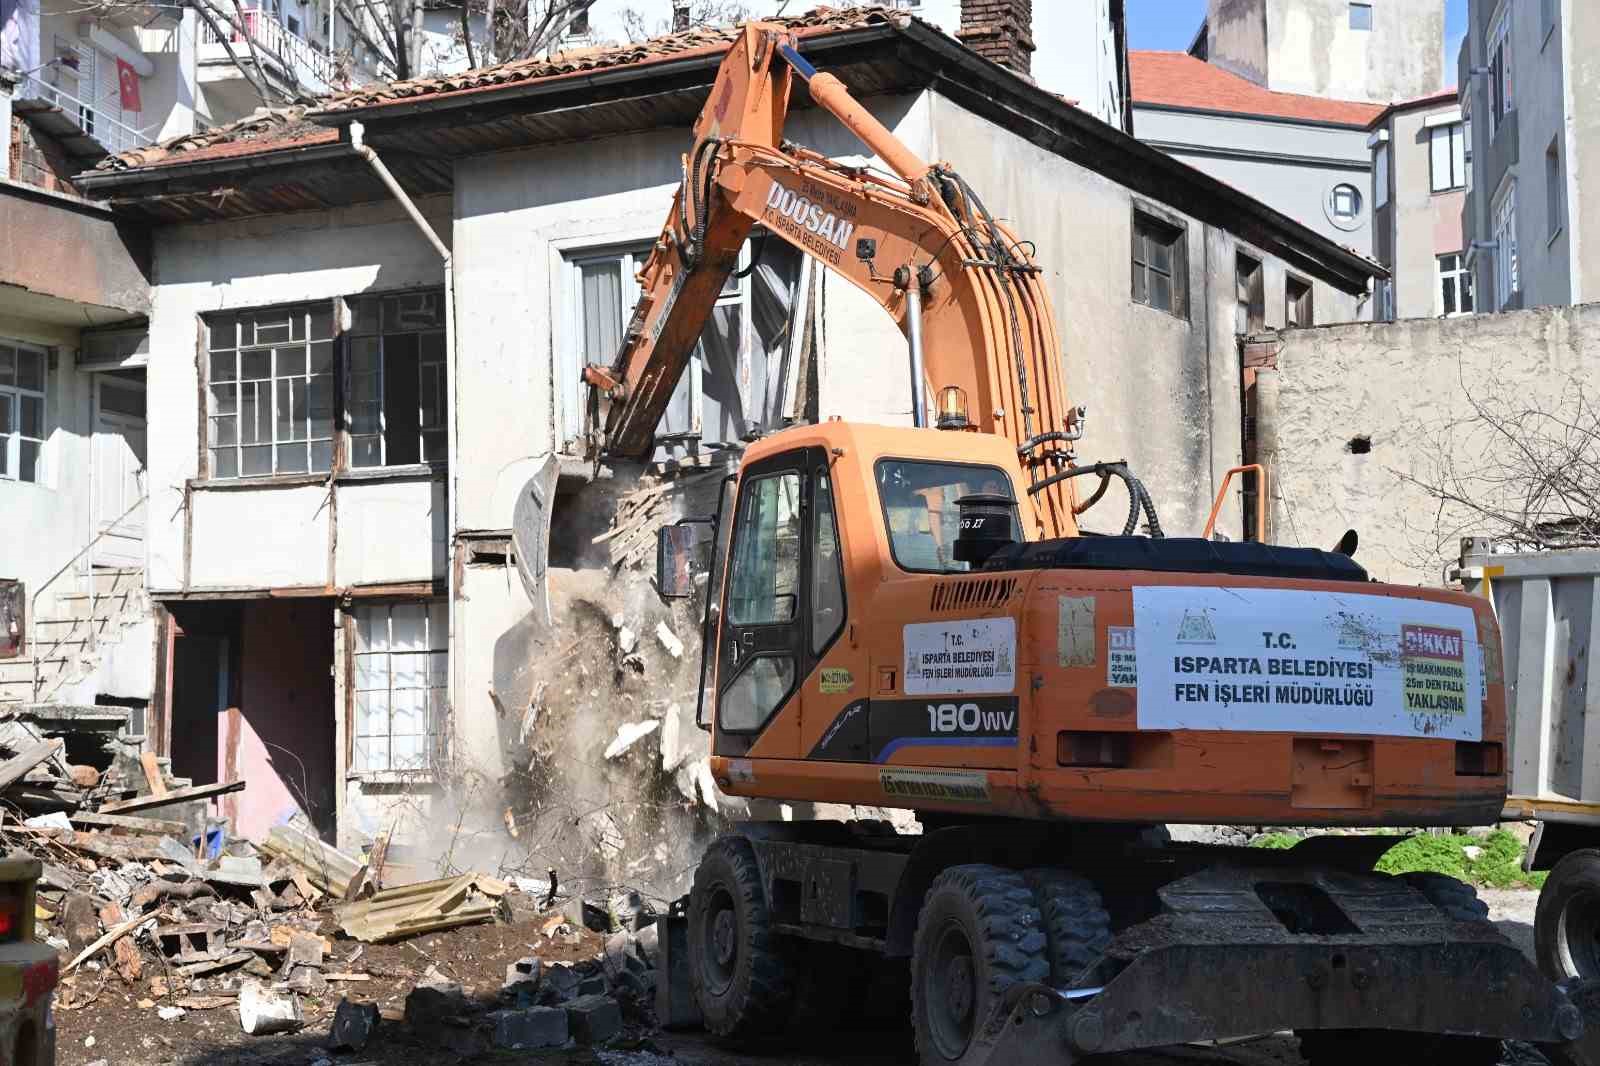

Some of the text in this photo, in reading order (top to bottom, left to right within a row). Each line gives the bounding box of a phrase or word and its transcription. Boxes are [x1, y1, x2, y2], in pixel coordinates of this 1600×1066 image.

[767, 181, 853, 250] DOOSAN
[775, 216, 801, 241] ISPARTA
[951, 634, 964, 646] T.C.
[1262, 632, 1297, 649] T.C.
[1405, 627, 1460, 656] DİKKAT
[922, 650, 951, 664] ISPARTA
[1174, 656, 1374, 679] ISPARTA BELEDİYESİ
[922, 667, 934, 679] FEN
[1175, 680, 1374, 708] FEN İŞLERİ MÜDÜRLÜĞÜ
[1425, 679, 1441, 690] DEN
[1441, 680, 1464, 692] FAZLA
[1406, 692, 1464, 715] YAKLAŞMA
